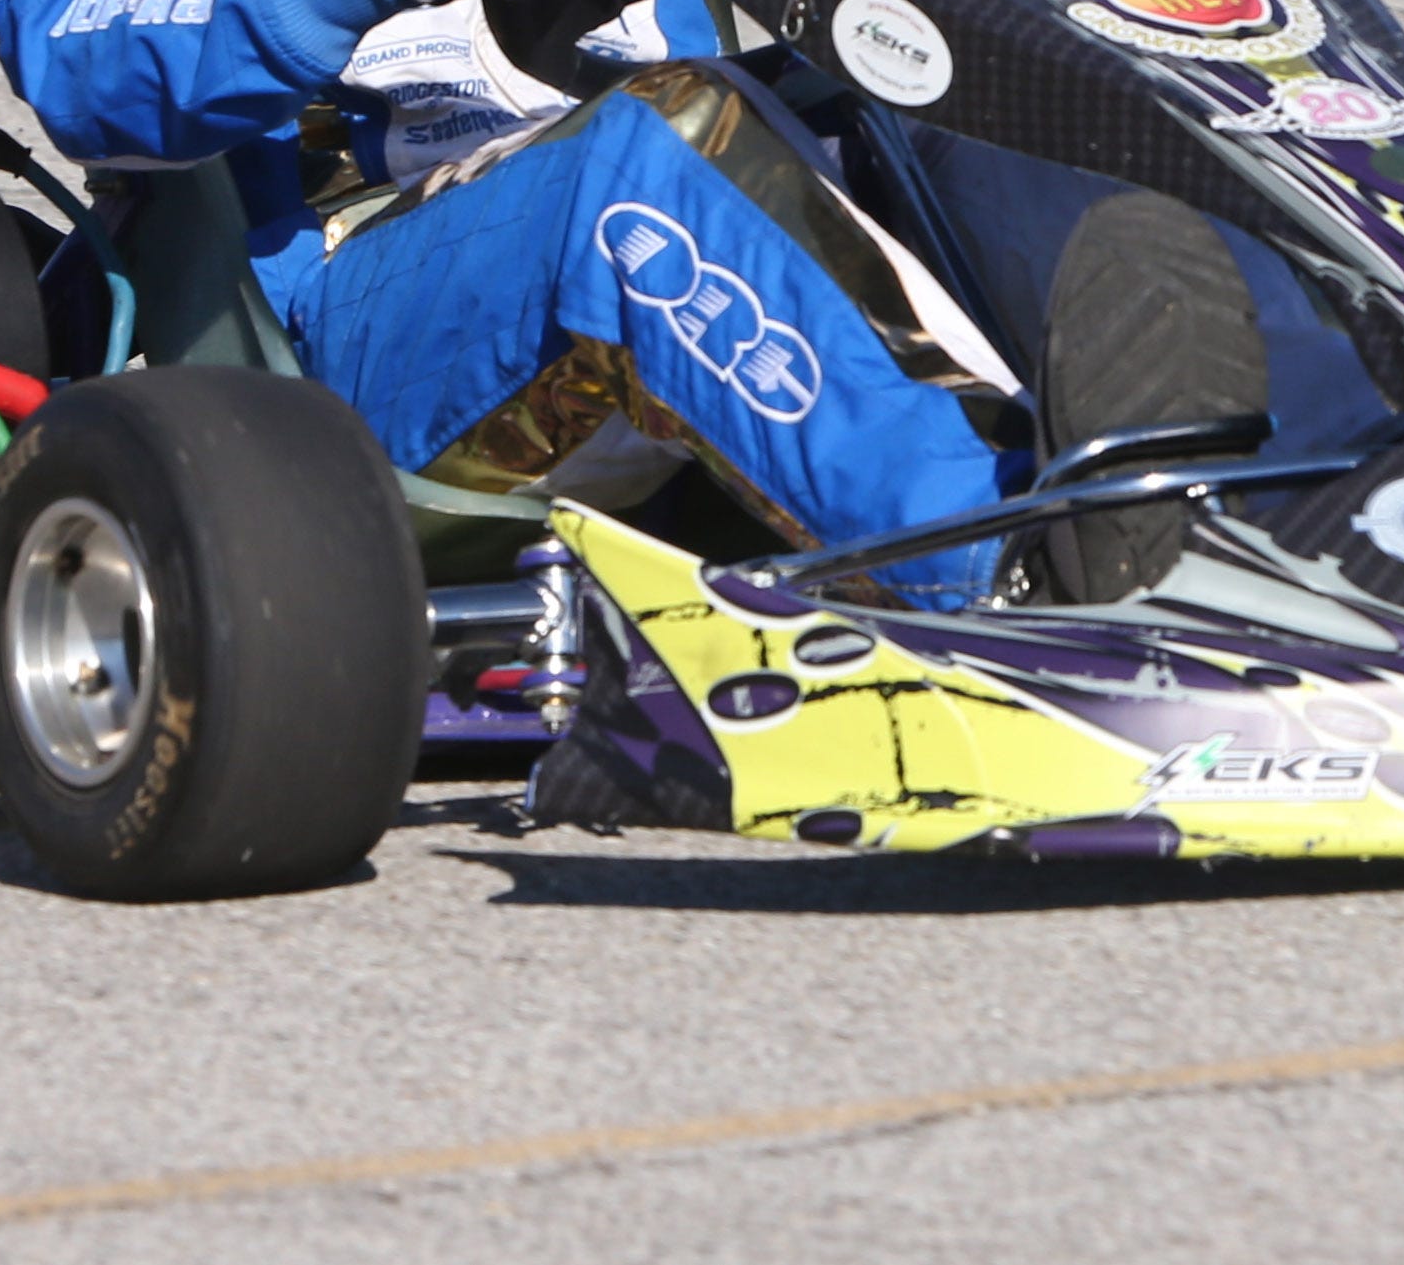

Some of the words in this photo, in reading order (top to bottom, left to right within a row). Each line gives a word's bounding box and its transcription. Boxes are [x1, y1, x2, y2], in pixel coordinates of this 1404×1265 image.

[355, 46, 411, 69] GRAND
[1299, 90, 1379, 126] 20
[1203, 751, 1370, 782] EKS
